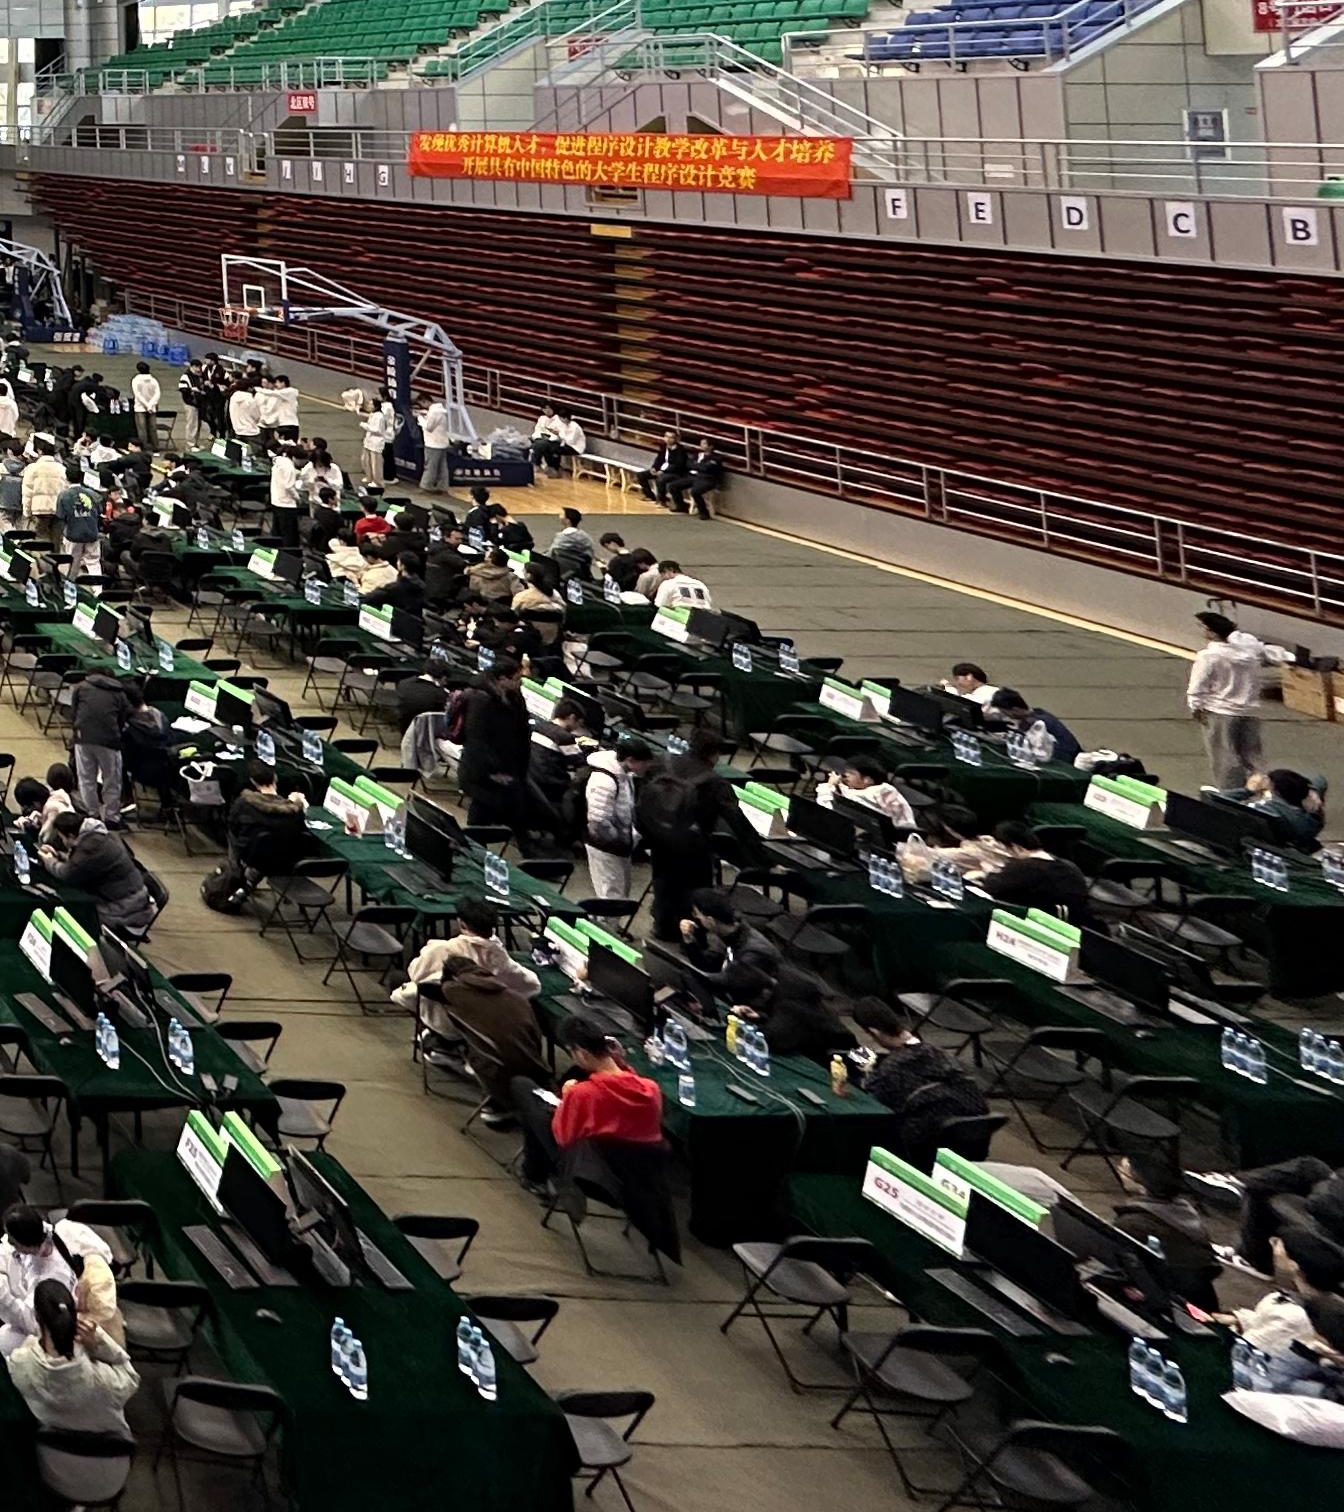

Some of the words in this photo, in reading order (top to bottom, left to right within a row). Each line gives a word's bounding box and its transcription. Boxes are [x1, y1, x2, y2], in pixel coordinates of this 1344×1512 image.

[891, 198, 901, 216] F
[974, 202, 986, 220] E
[1066, 206, 1083, 226] D
[1173, 212, 1191, 234] C
[1290, 218, 1311, 241] B
[874, 1176, 900, 1200] G25
